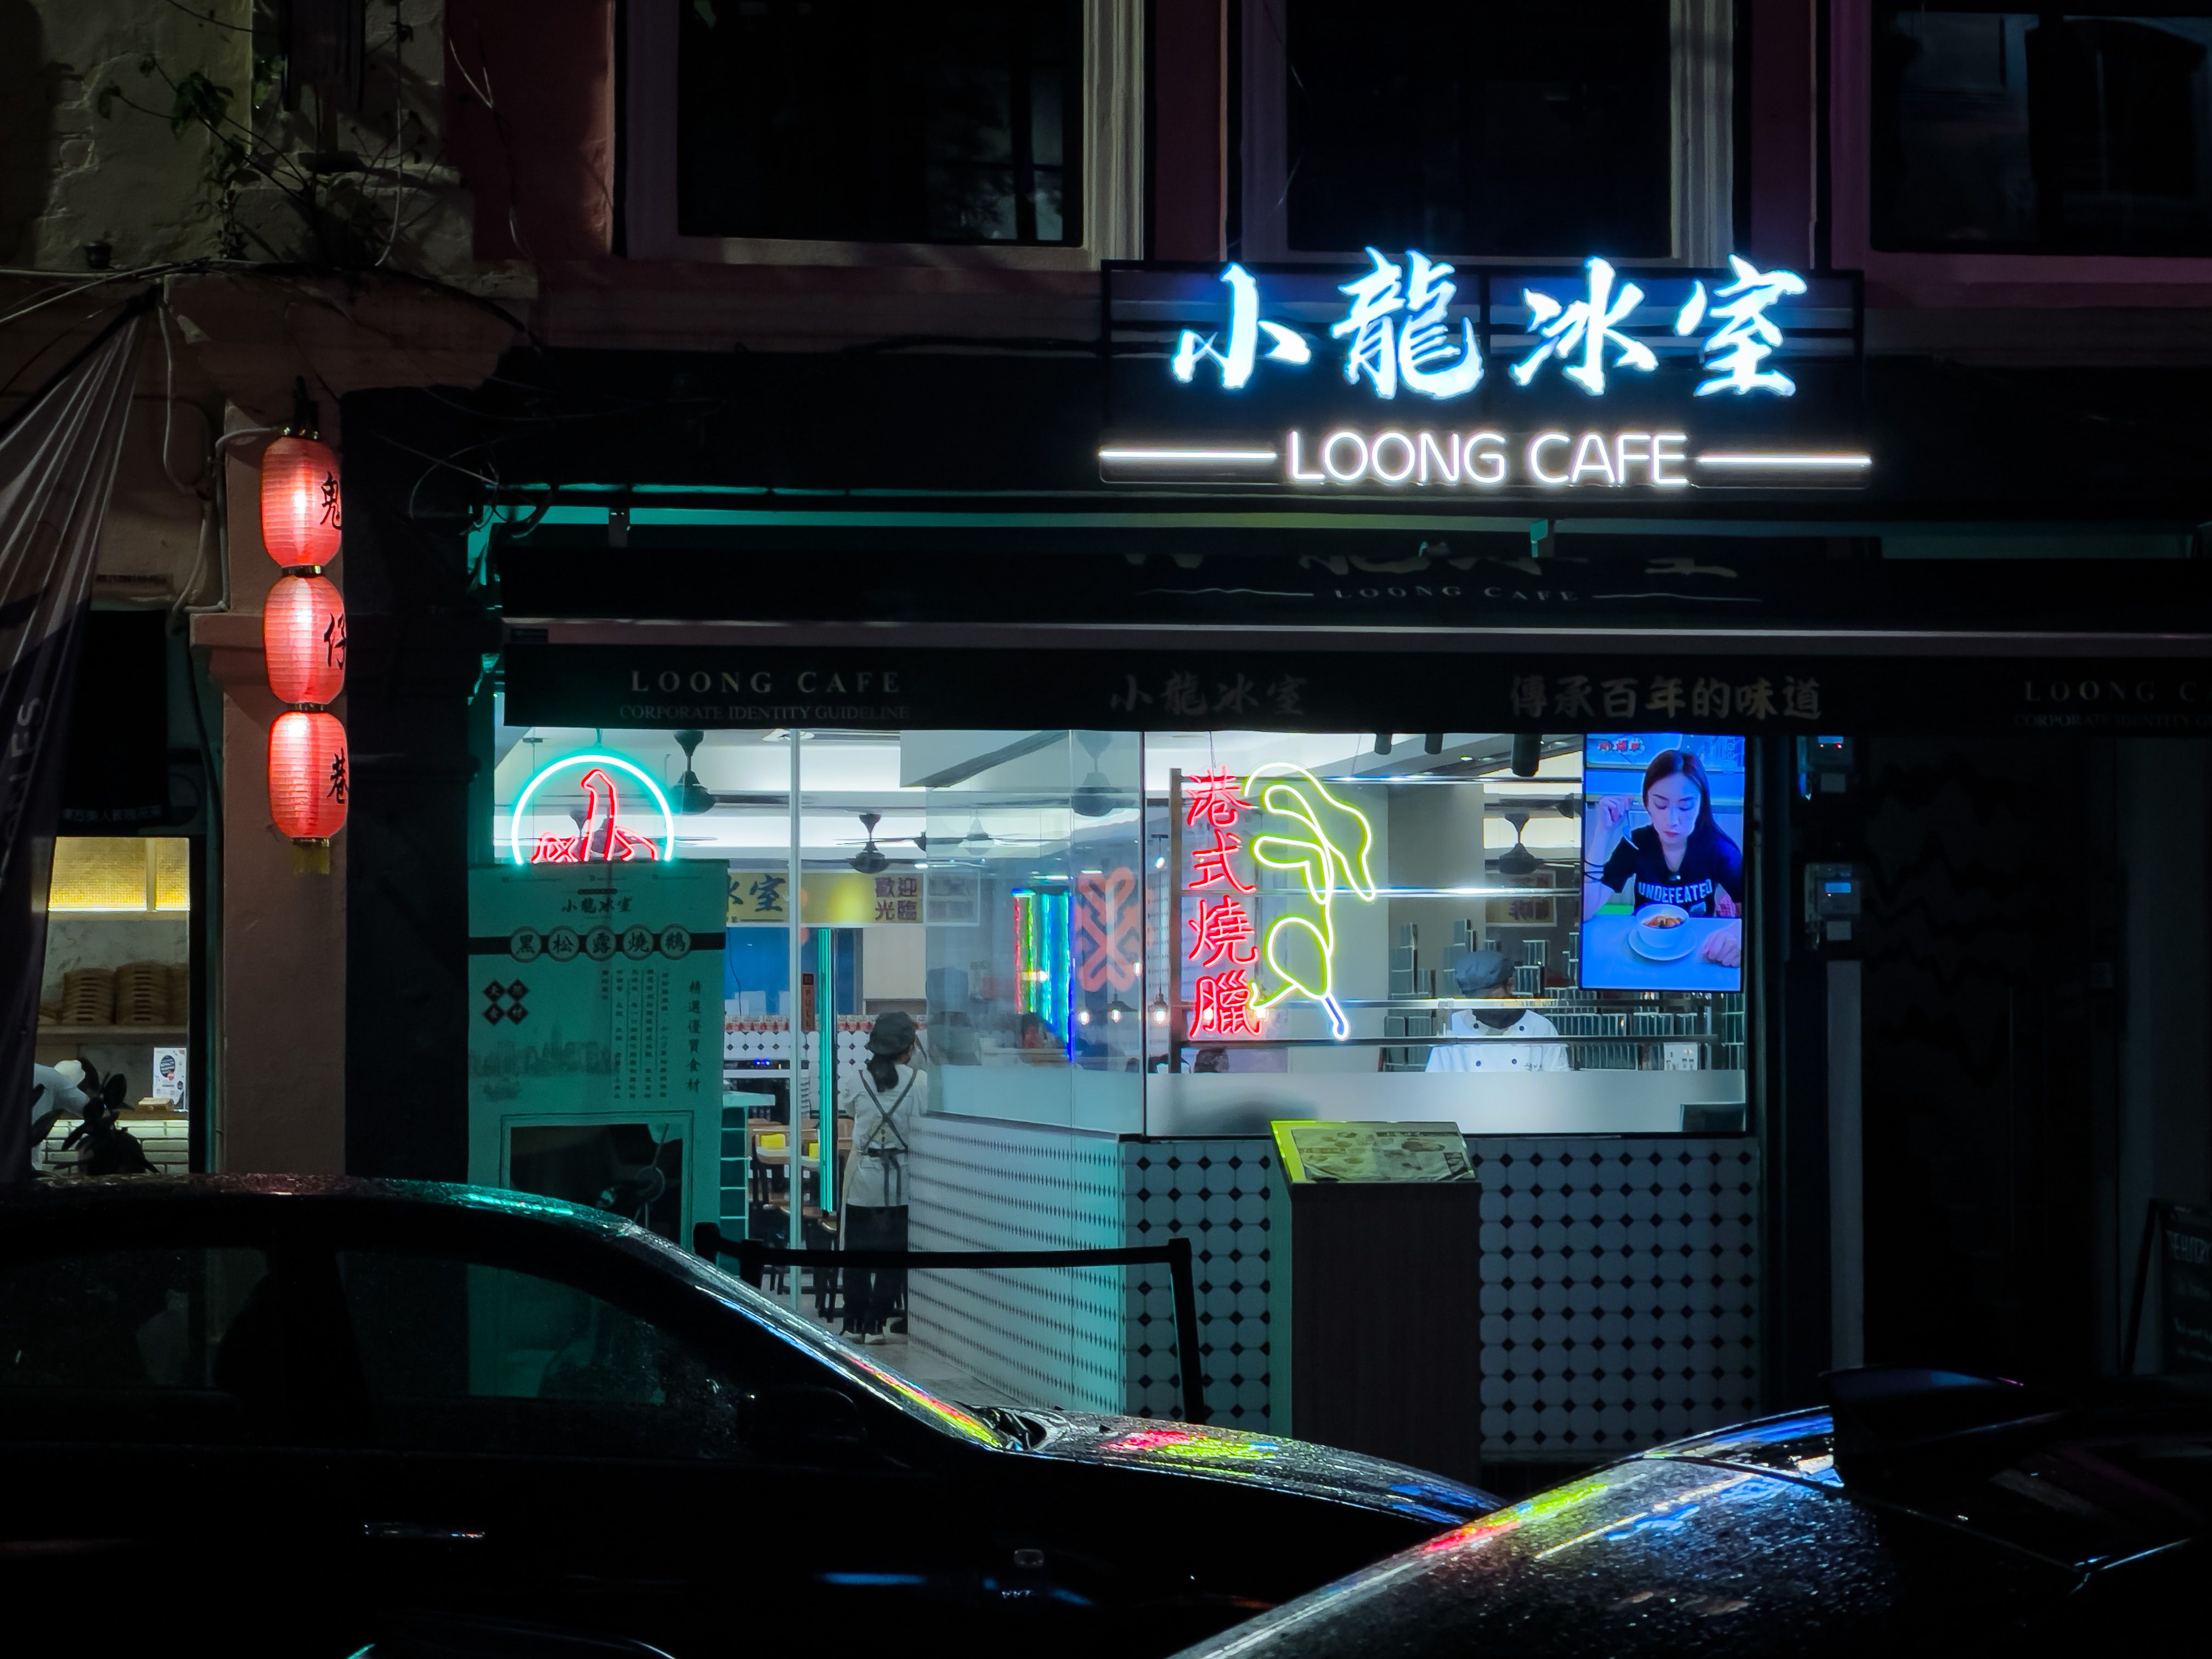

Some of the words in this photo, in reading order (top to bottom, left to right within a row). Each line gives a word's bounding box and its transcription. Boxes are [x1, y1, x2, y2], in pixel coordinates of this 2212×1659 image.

[1171, 246, 1808, 400] 小龍冰室
[1288, 430, 1507, 486] LOONG
[1528, 432, 1690, 487] CAFE
[1334, 585, 1462, 599] LOONG
[1483, 586, 1579, 601] CAFE
[630, 670, 772, 693] LOONG
[796, 671, 900, 693] CAFE
[1110, 670, 1307, 715] 小龍冰室
[2023, 679, 2156, 703] LOONG
[1510, 674, 1822, 720] 傳承百年的味道
[619, 704, 724, 721] CORPORATE
[729, 704, 811, 721] IDENTITY
[814, 705, 911, 721] GUIDELINE
[1638, 878, 1713, 904] UNDEFEATED
